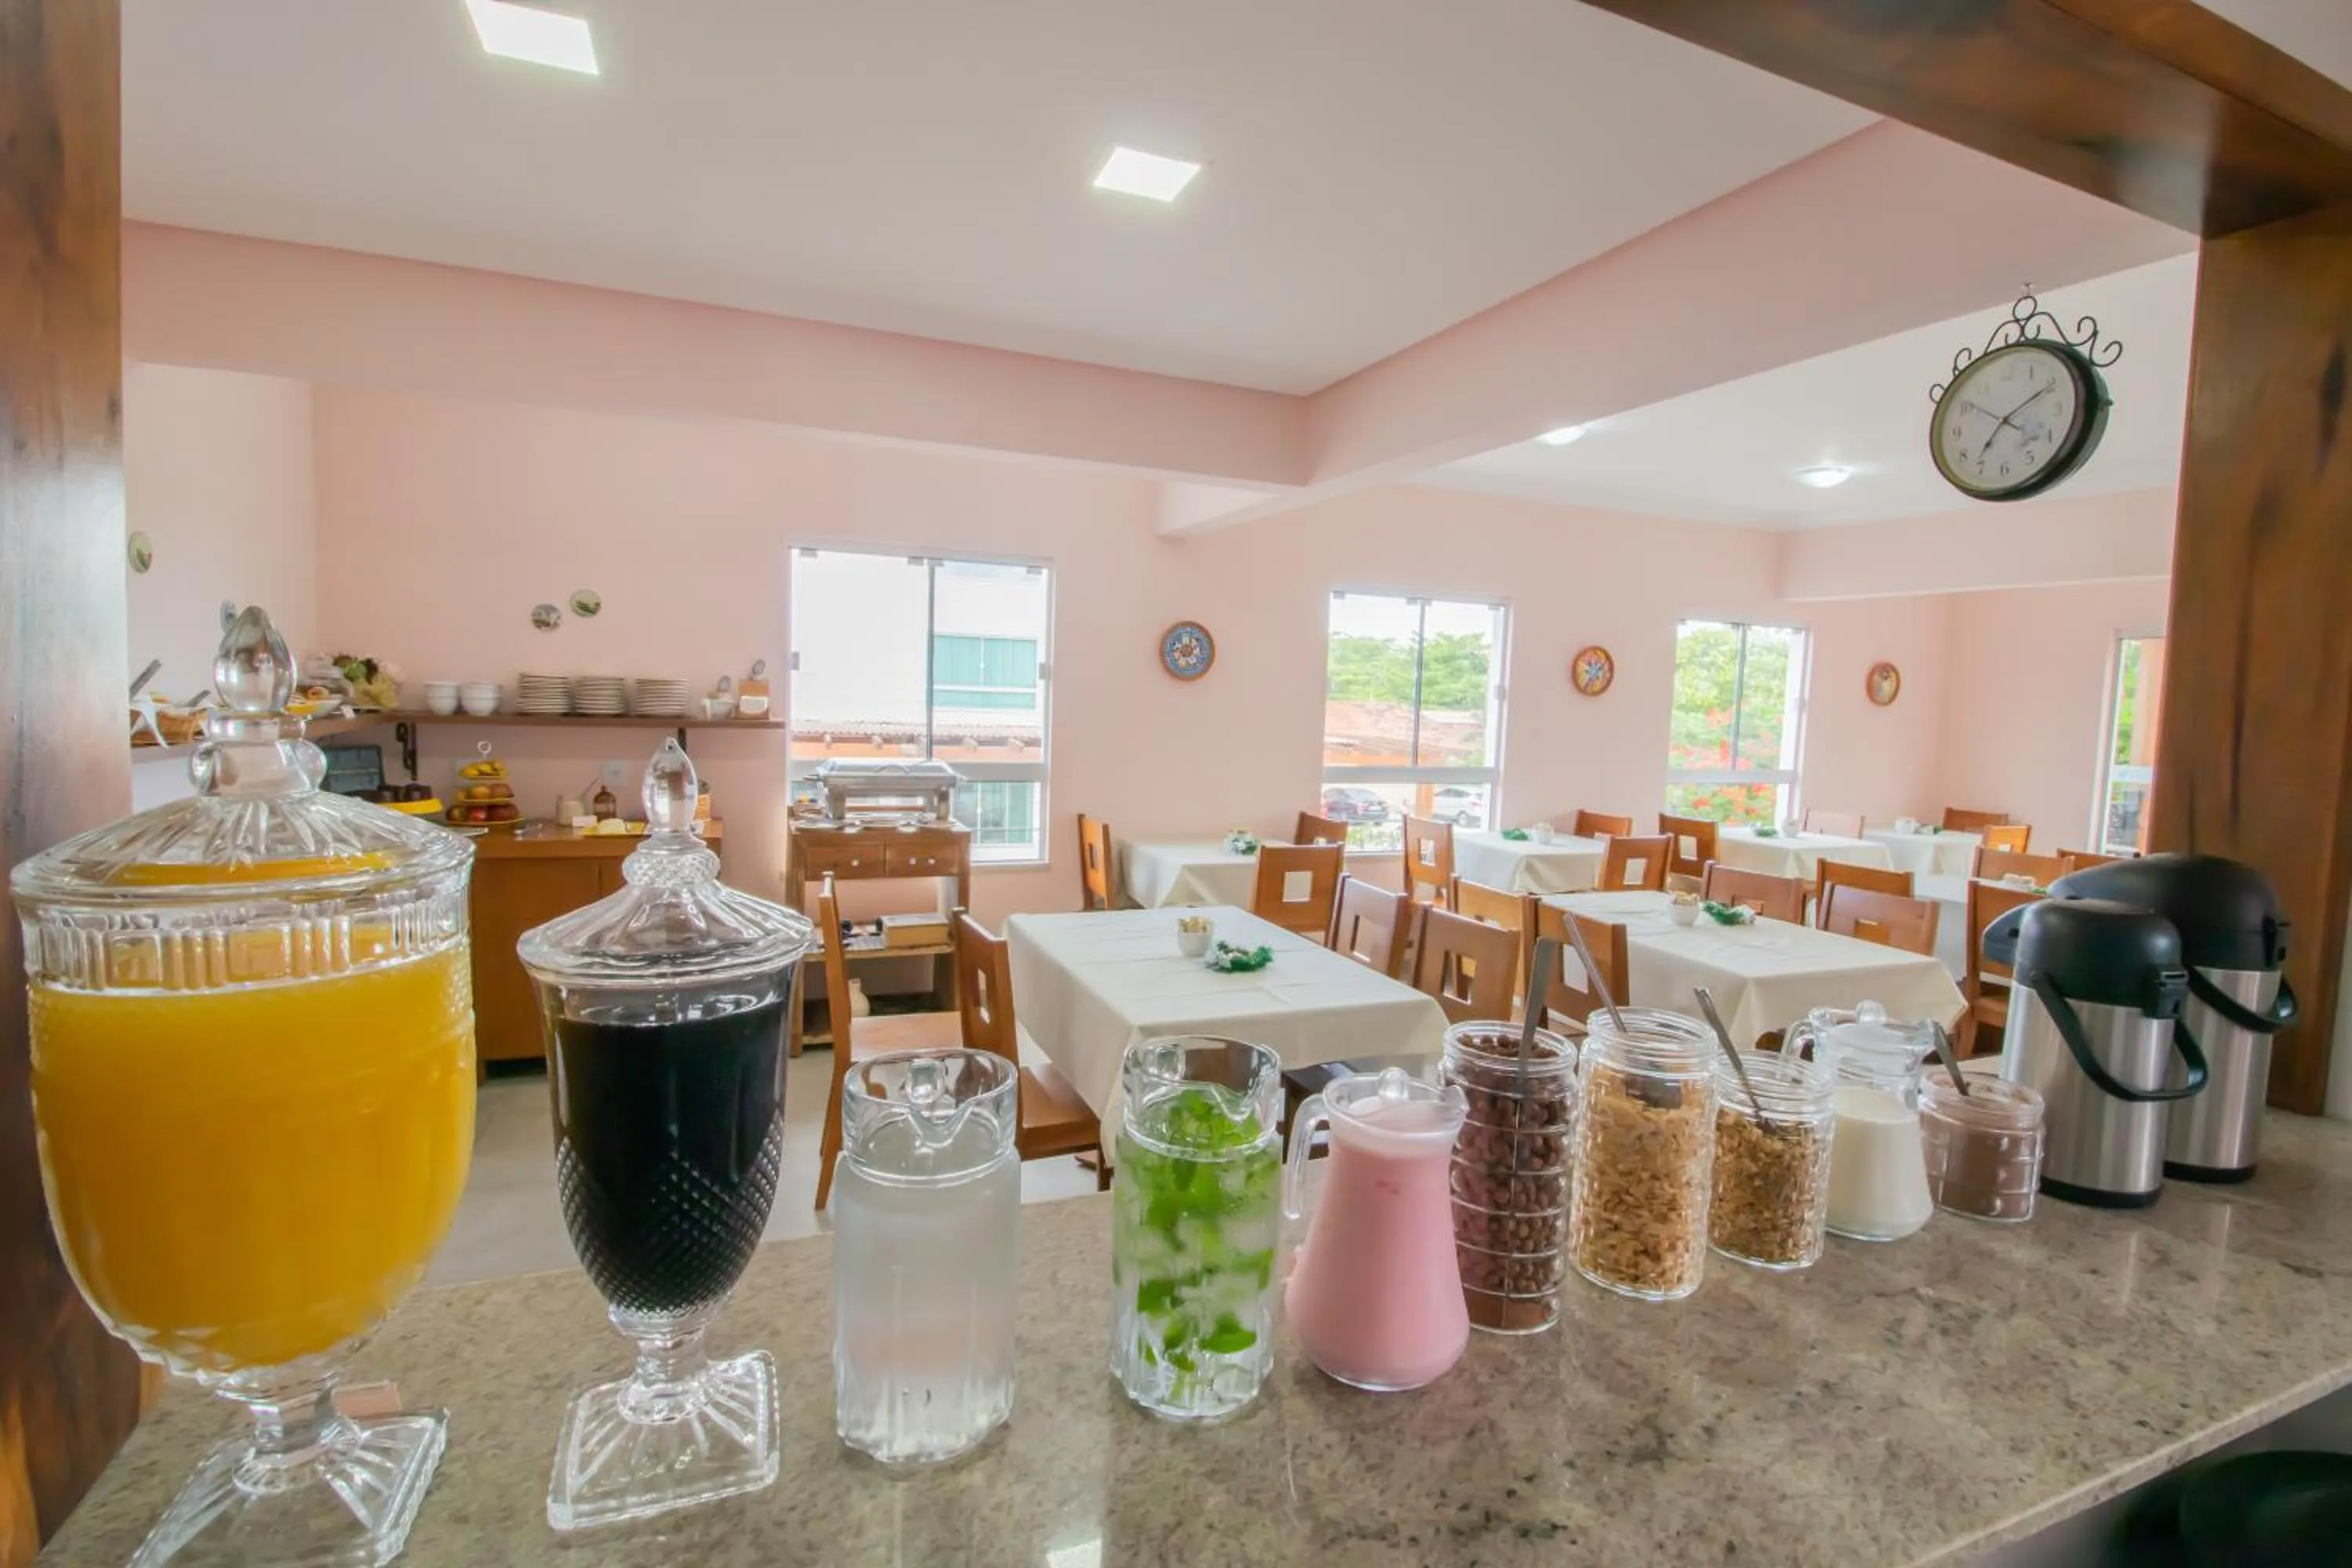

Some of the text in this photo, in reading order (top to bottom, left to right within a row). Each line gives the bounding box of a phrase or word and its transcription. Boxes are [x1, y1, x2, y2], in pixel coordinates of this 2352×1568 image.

[1951, 426, 1962, 441] 9
[1958, 448, 1969, 463] 8
[2024, 450, 2036, 466] 5
[1975, 459, 1987, 476] 7
[1998, 461, 2010, 477] 6
